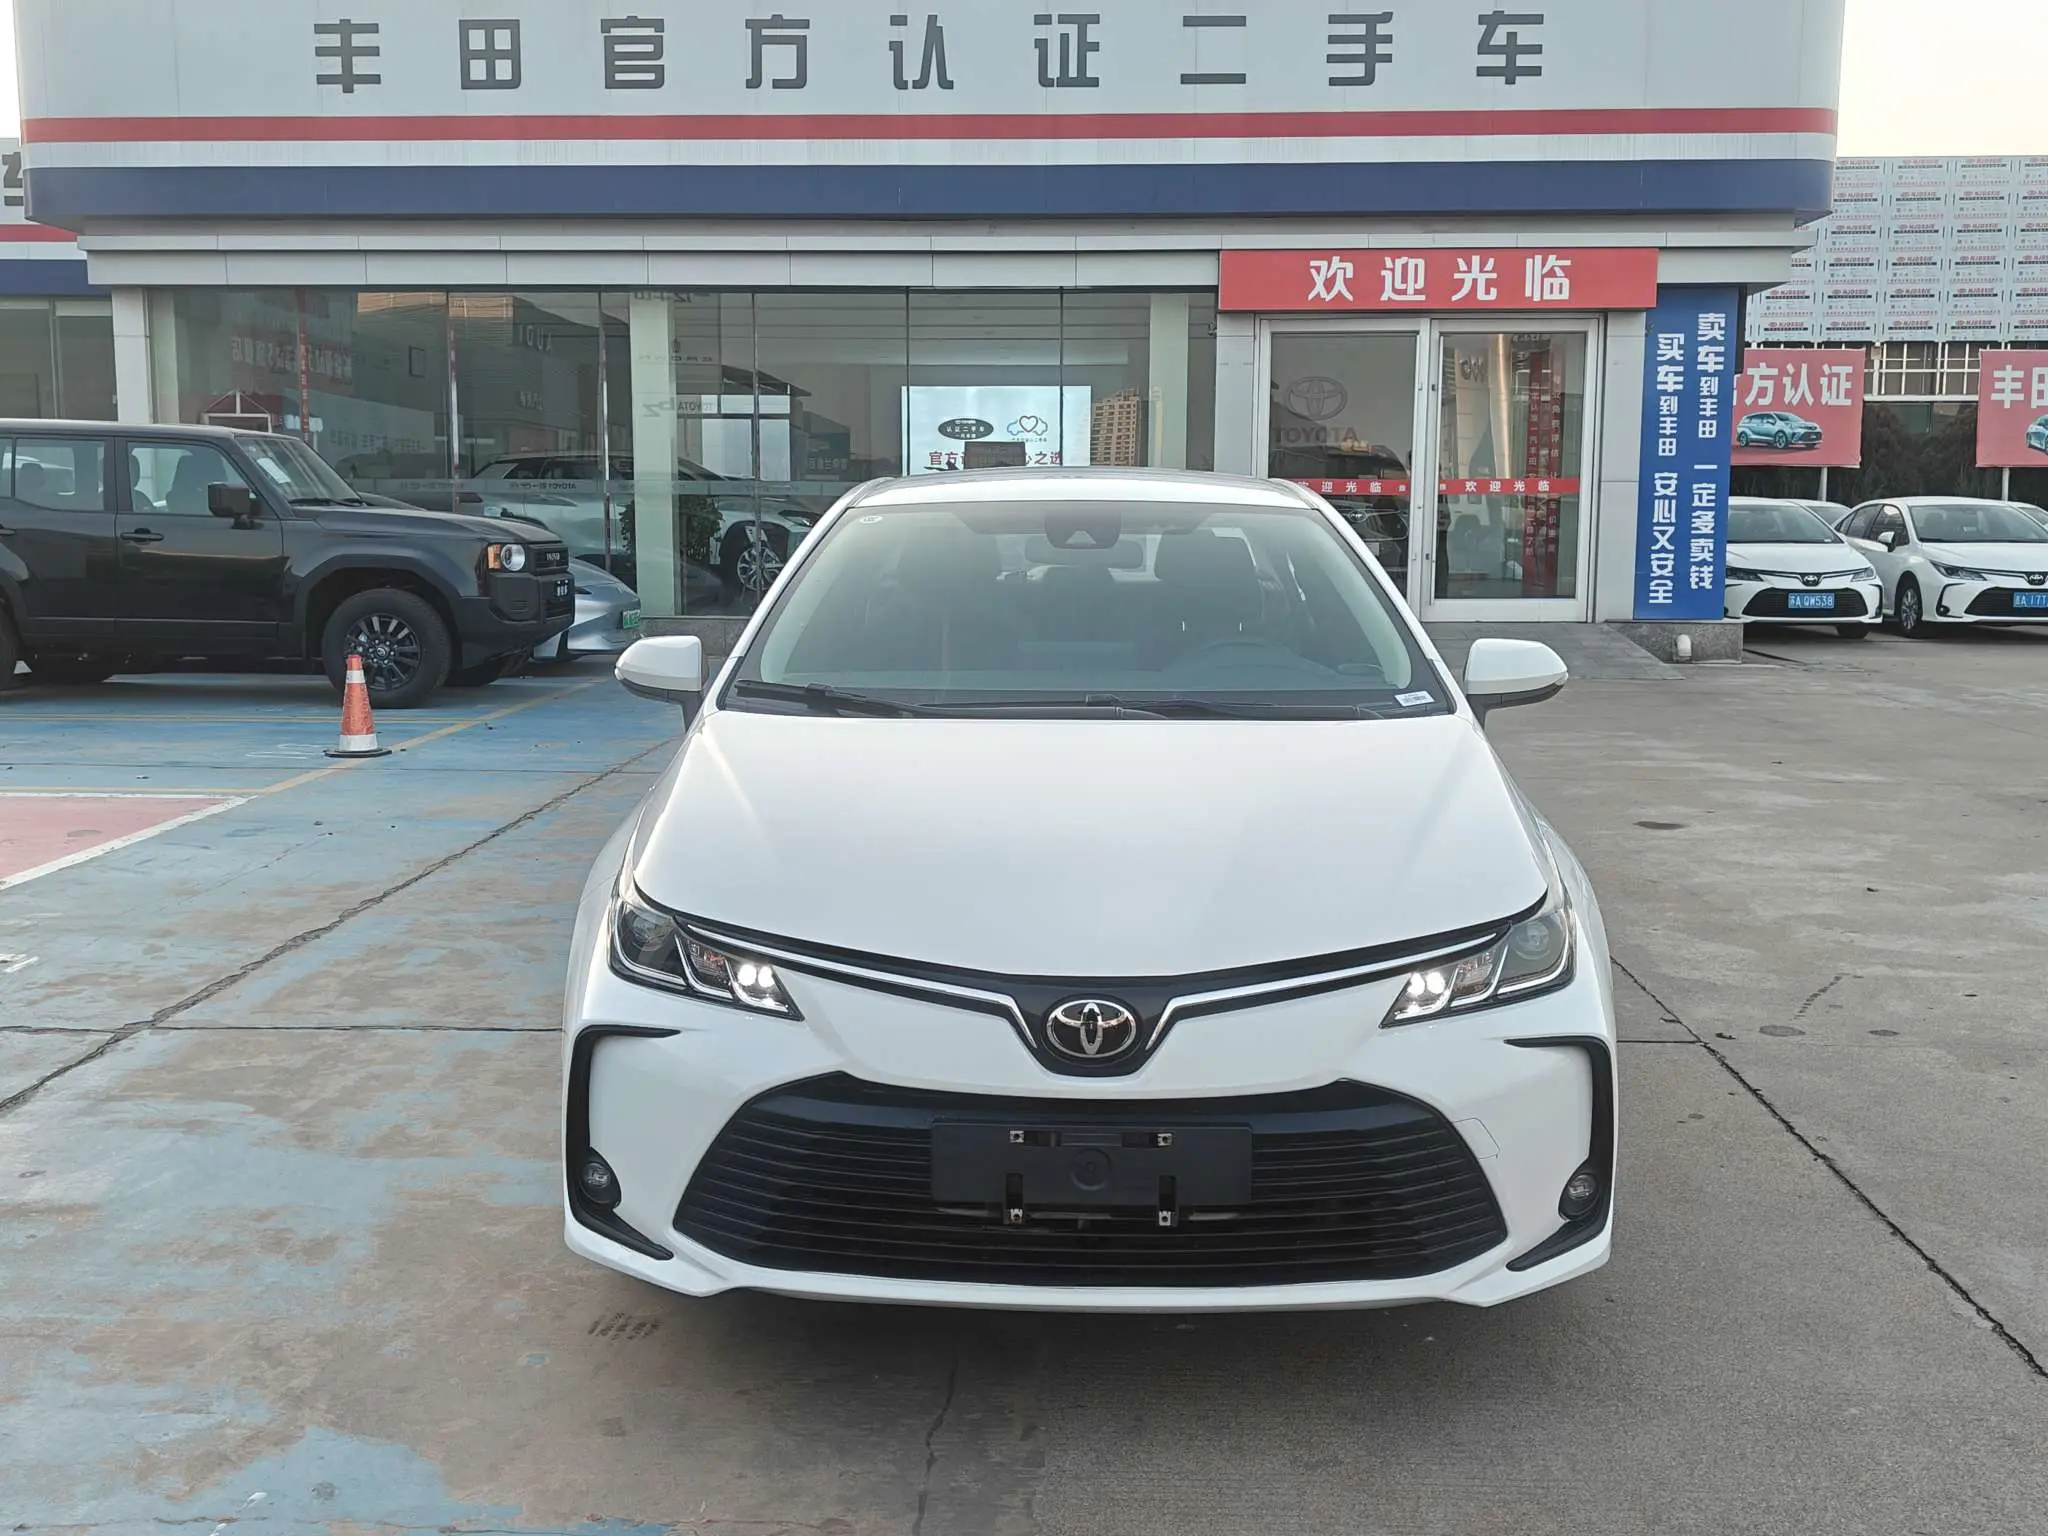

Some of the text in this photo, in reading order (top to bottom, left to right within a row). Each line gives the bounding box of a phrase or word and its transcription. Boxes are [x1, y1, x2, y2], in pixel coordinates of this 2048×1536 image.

[314, 11, 1544, 93] 丰田官方认证二手车
[1307, 254, 1571, 302] 欢迎光临
[1733, 362, 1854, 408] 方认证
[1648, 333, 1685, 604] 买车到丰田 安心又安全
[1690, 313, 1727, 589] 卖车到丰田 一定多卖钱
[1465, 480, 1551, 493] 欢迎光临
